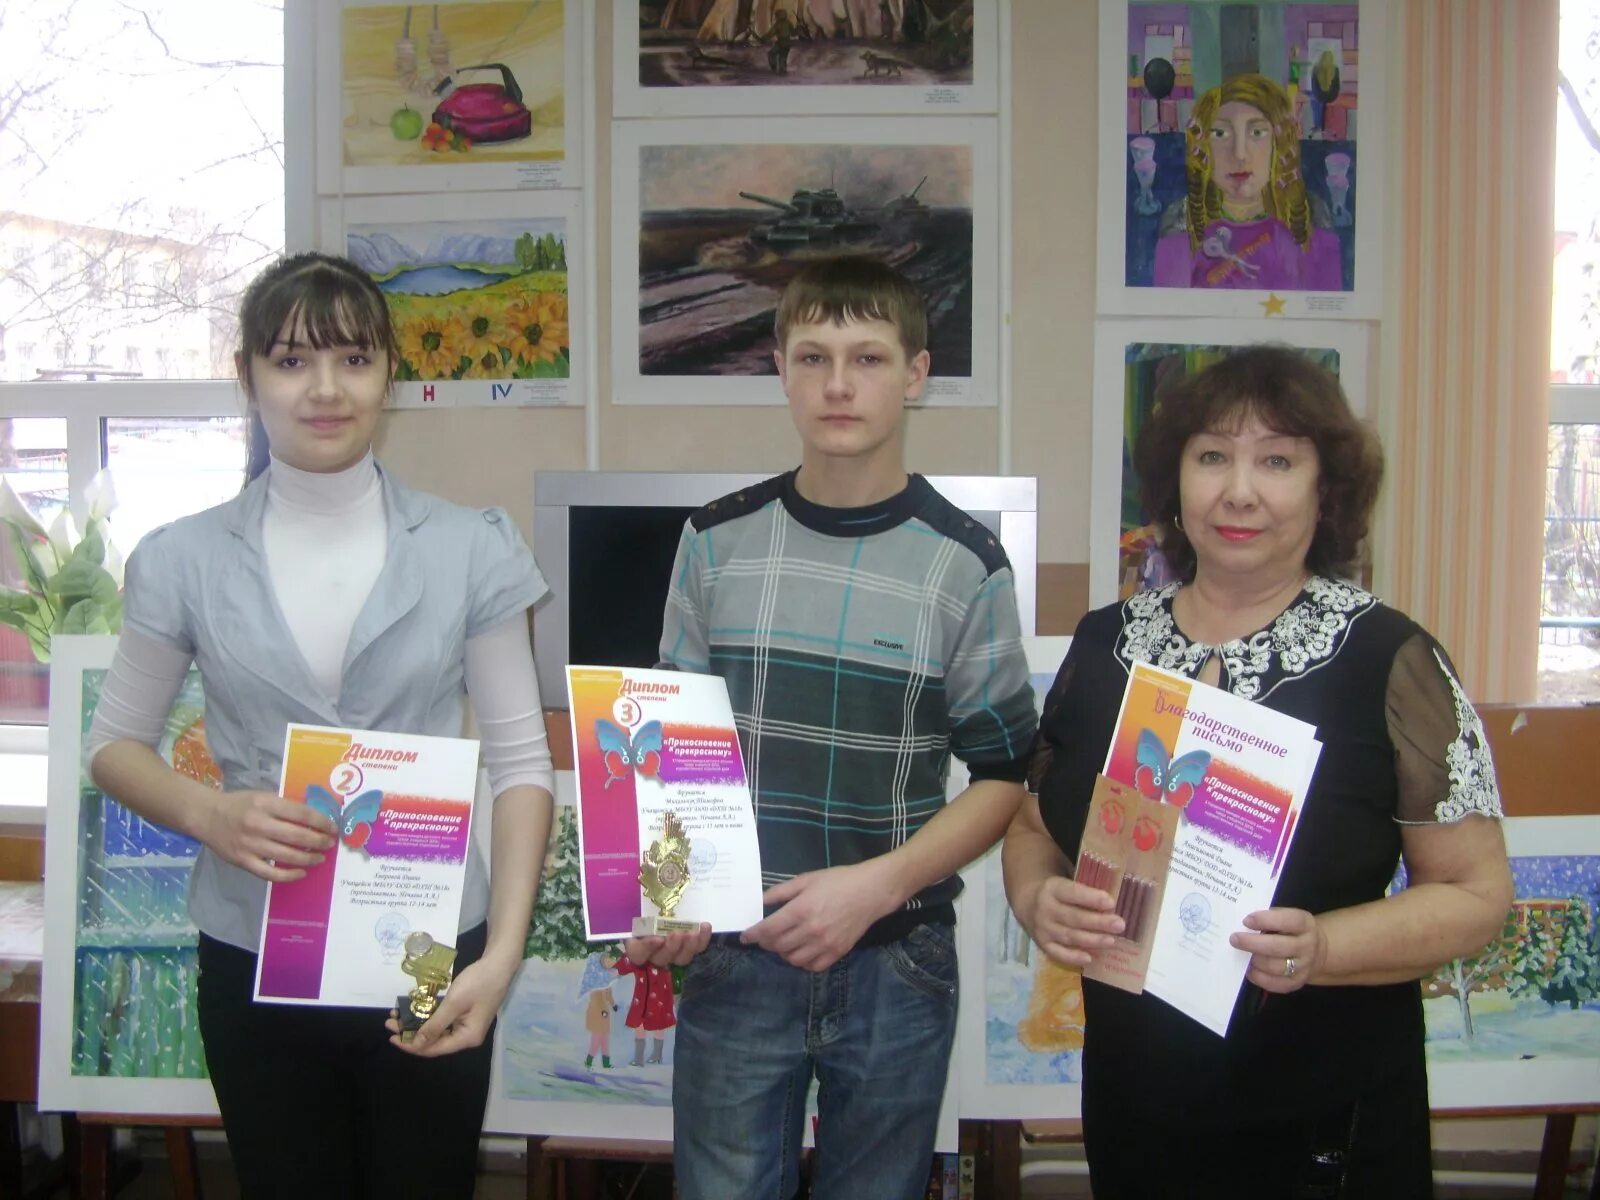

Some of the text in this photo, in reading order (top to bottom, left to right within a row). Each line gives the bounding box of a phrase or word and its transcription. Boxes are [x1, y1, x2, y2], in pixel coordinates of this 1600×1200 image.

[492, 383, 513, 401] IV
[873, 638, 904, 650] EXCLUSIVE
[620, 678, 680, 695] Диплом
[620, 703, 634, 723] 3
[1154, 687, 1288, 758] Благодарственное
[663, 737, 732, 748] «Прикосновение
[1191, 725, 1243, 753] письмо
[342, 743, 419, 763] Диплом
[674, 747, 732, 759] прекрасному»
[361, 761, 399, 771] степени
[336, 770, 355, 792] 2
[1203, 776, 1281, 814] «Прикосновение
[379, 809, 463, 824] «Прикосновение
[1211, 790, 1276, 825] прекрасному»
[389, 820, 460, 835] прекрасному»
